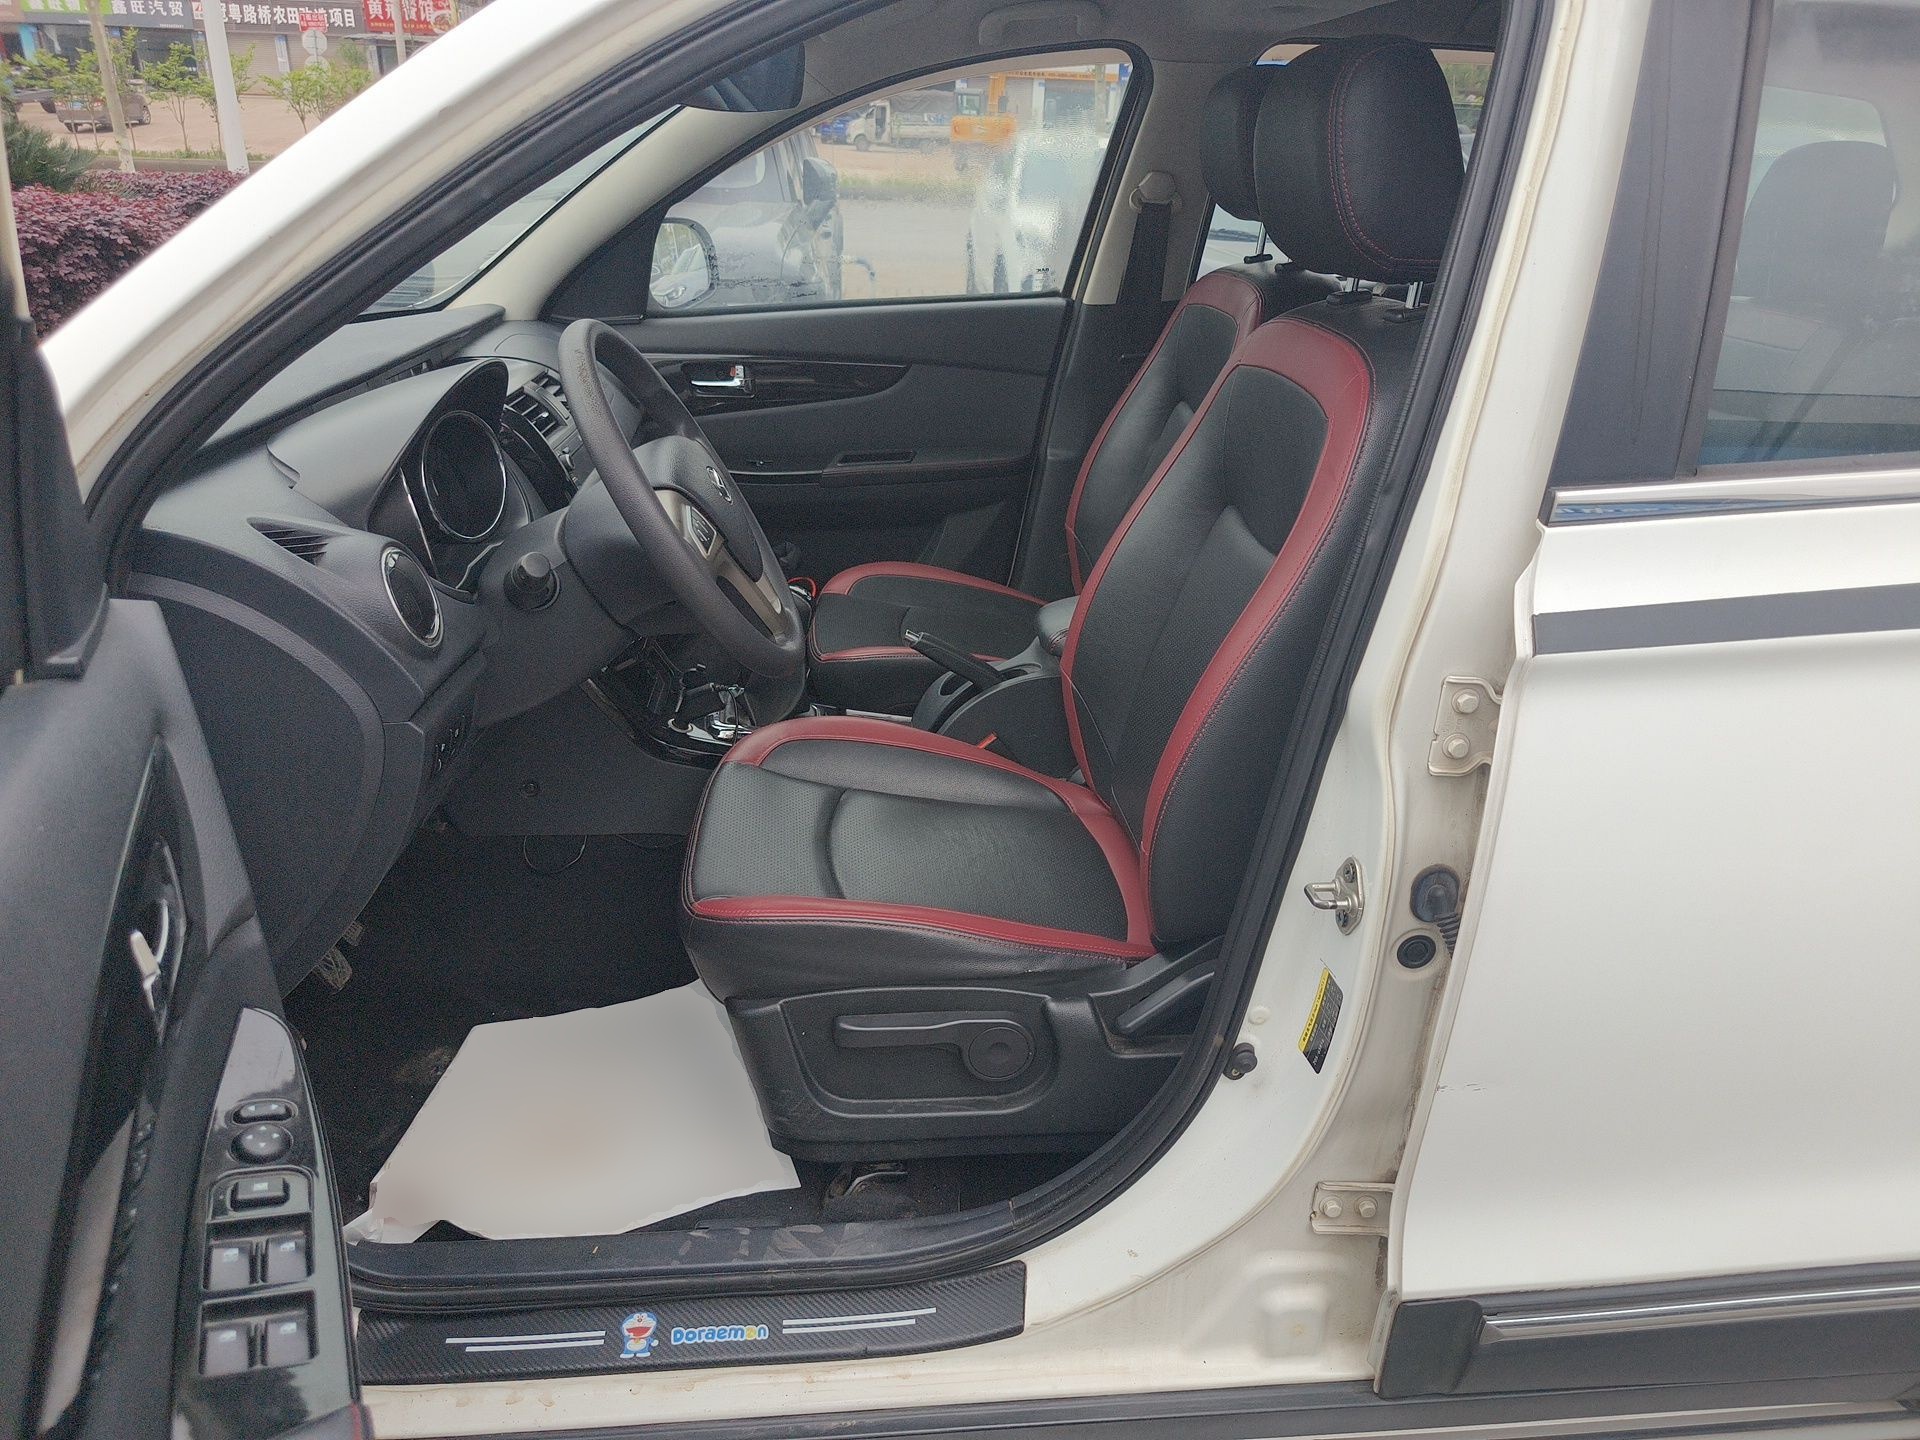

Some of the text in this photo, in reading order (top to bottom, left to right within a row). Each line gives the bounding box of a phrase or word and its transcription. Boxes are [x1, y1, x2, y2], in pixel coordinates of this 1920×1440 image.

[112, 0, 184, 17] 鑫旺汽贸
[671, 1324, 769, 1345] Doraemon
